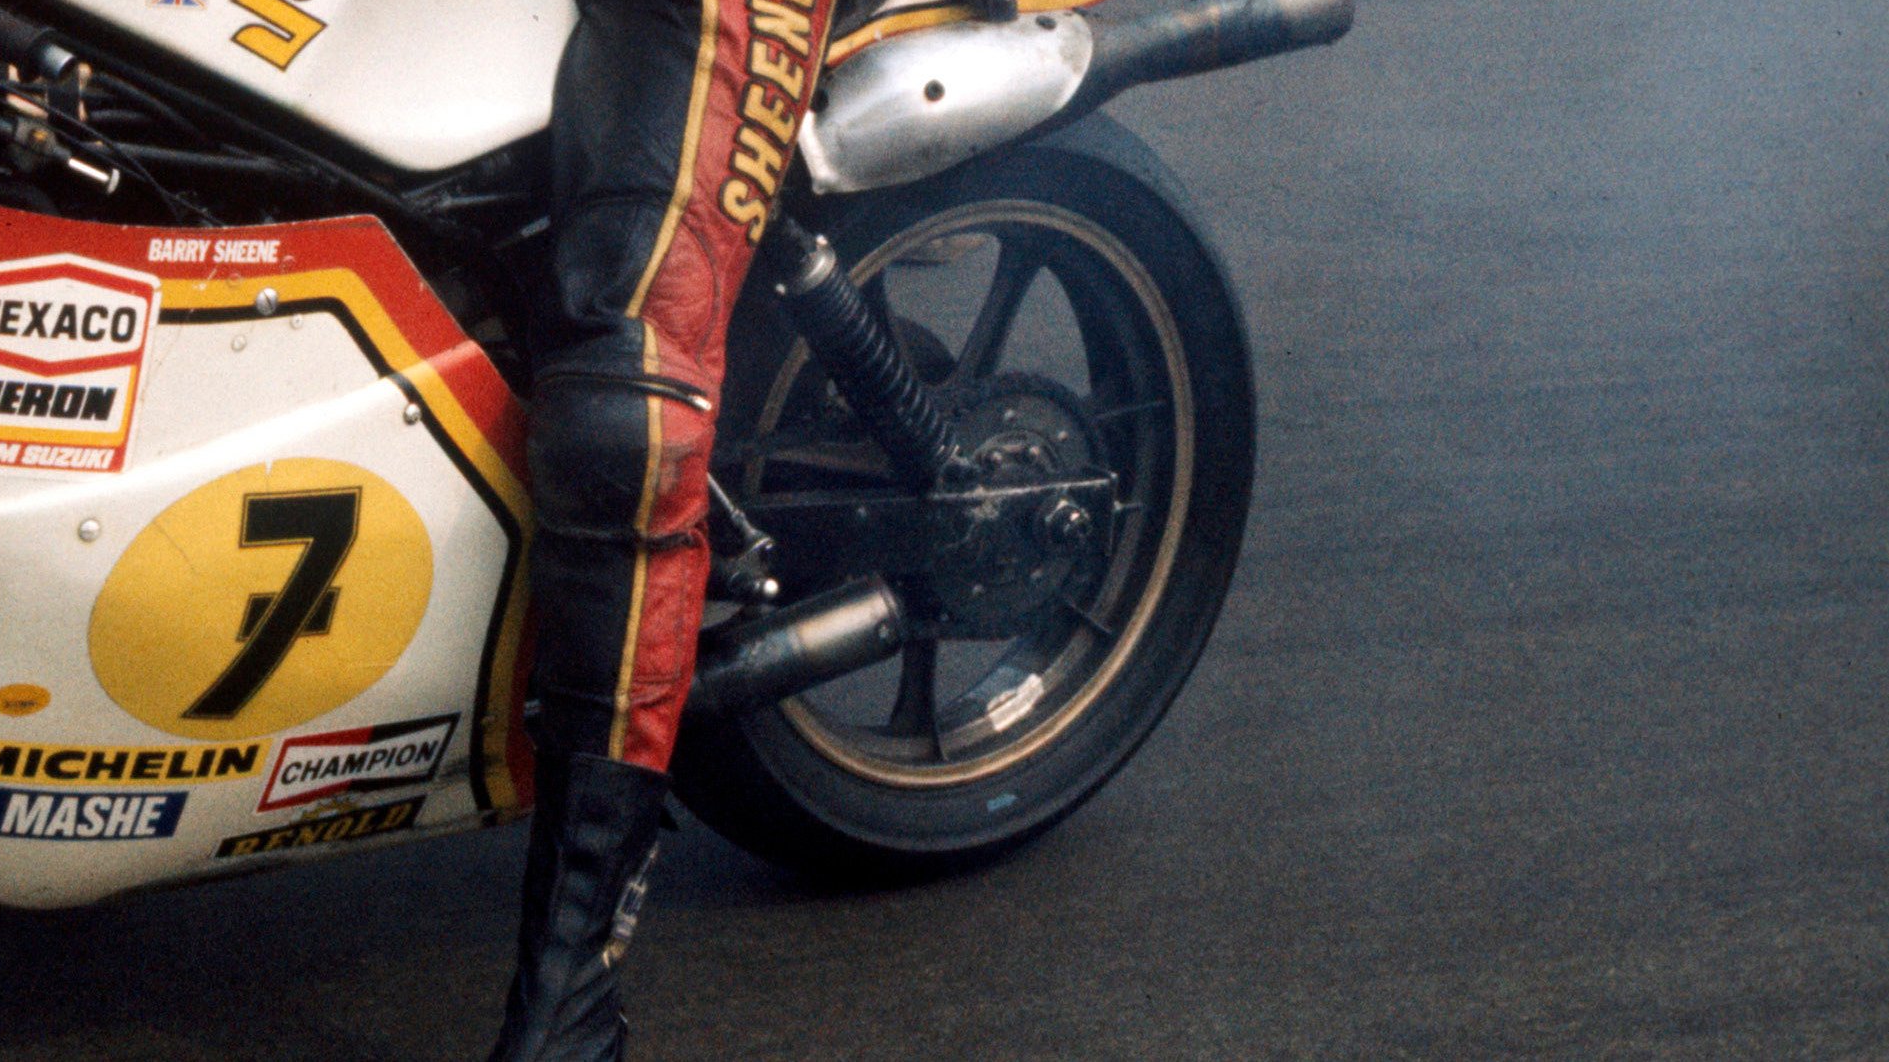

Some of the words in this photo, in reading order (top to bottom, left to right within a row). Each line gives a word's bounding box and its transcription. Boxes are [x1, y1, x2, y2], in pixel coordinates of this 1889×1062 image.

[148, 238, 213, 263] BARRY
[213, 239, 282, 264] SHEENE
[20, 444, 116, 470] SUZUKI
[178, 485, 363, 721] 7
[280, 739, 440, 786] CHAMPION
[0, 793, 168, 837] MASHE
[230, 802, 413, 855] RENOLD
